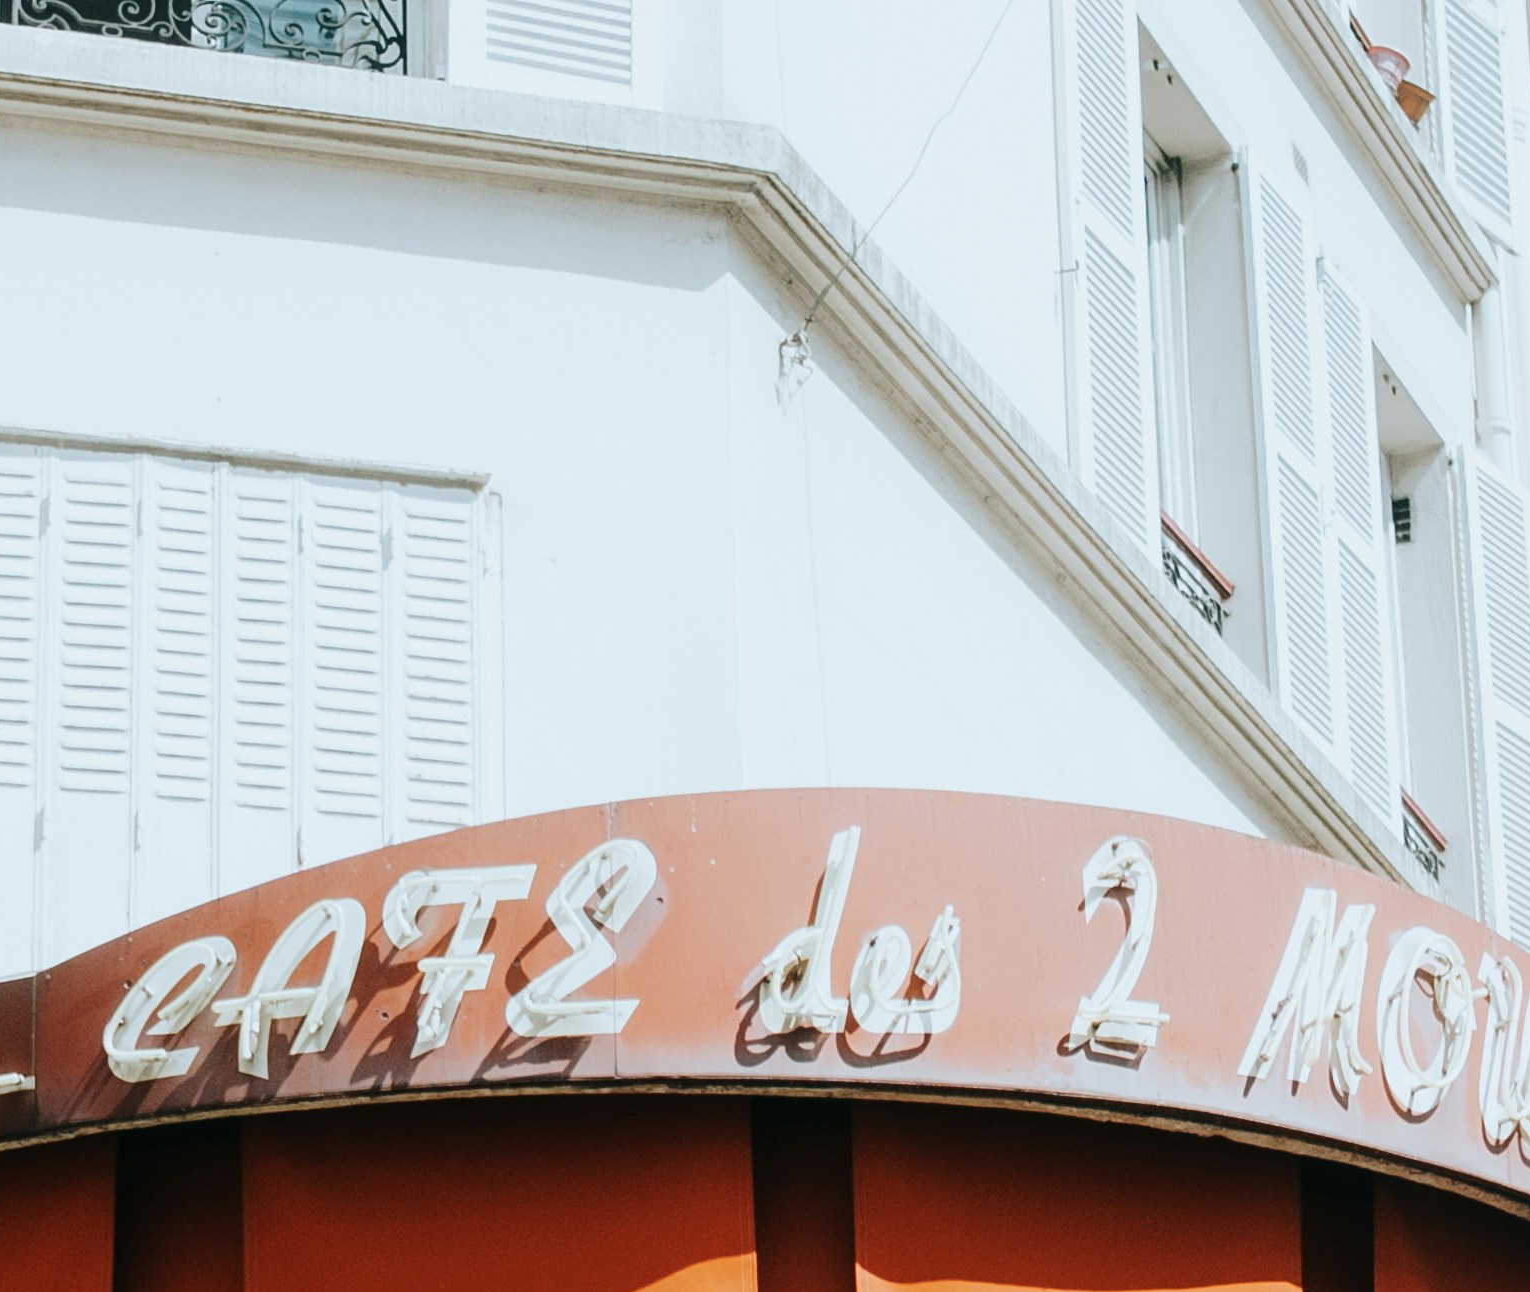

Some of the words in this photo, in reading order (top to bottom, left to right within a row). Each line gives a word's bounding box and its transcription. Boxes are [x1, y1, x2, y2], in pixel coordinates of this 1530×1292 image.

[102, 837, 659, 1083] CAFE
[758, 825, 961, 1035] des
[1068, 835, 1169, 1052] 2
